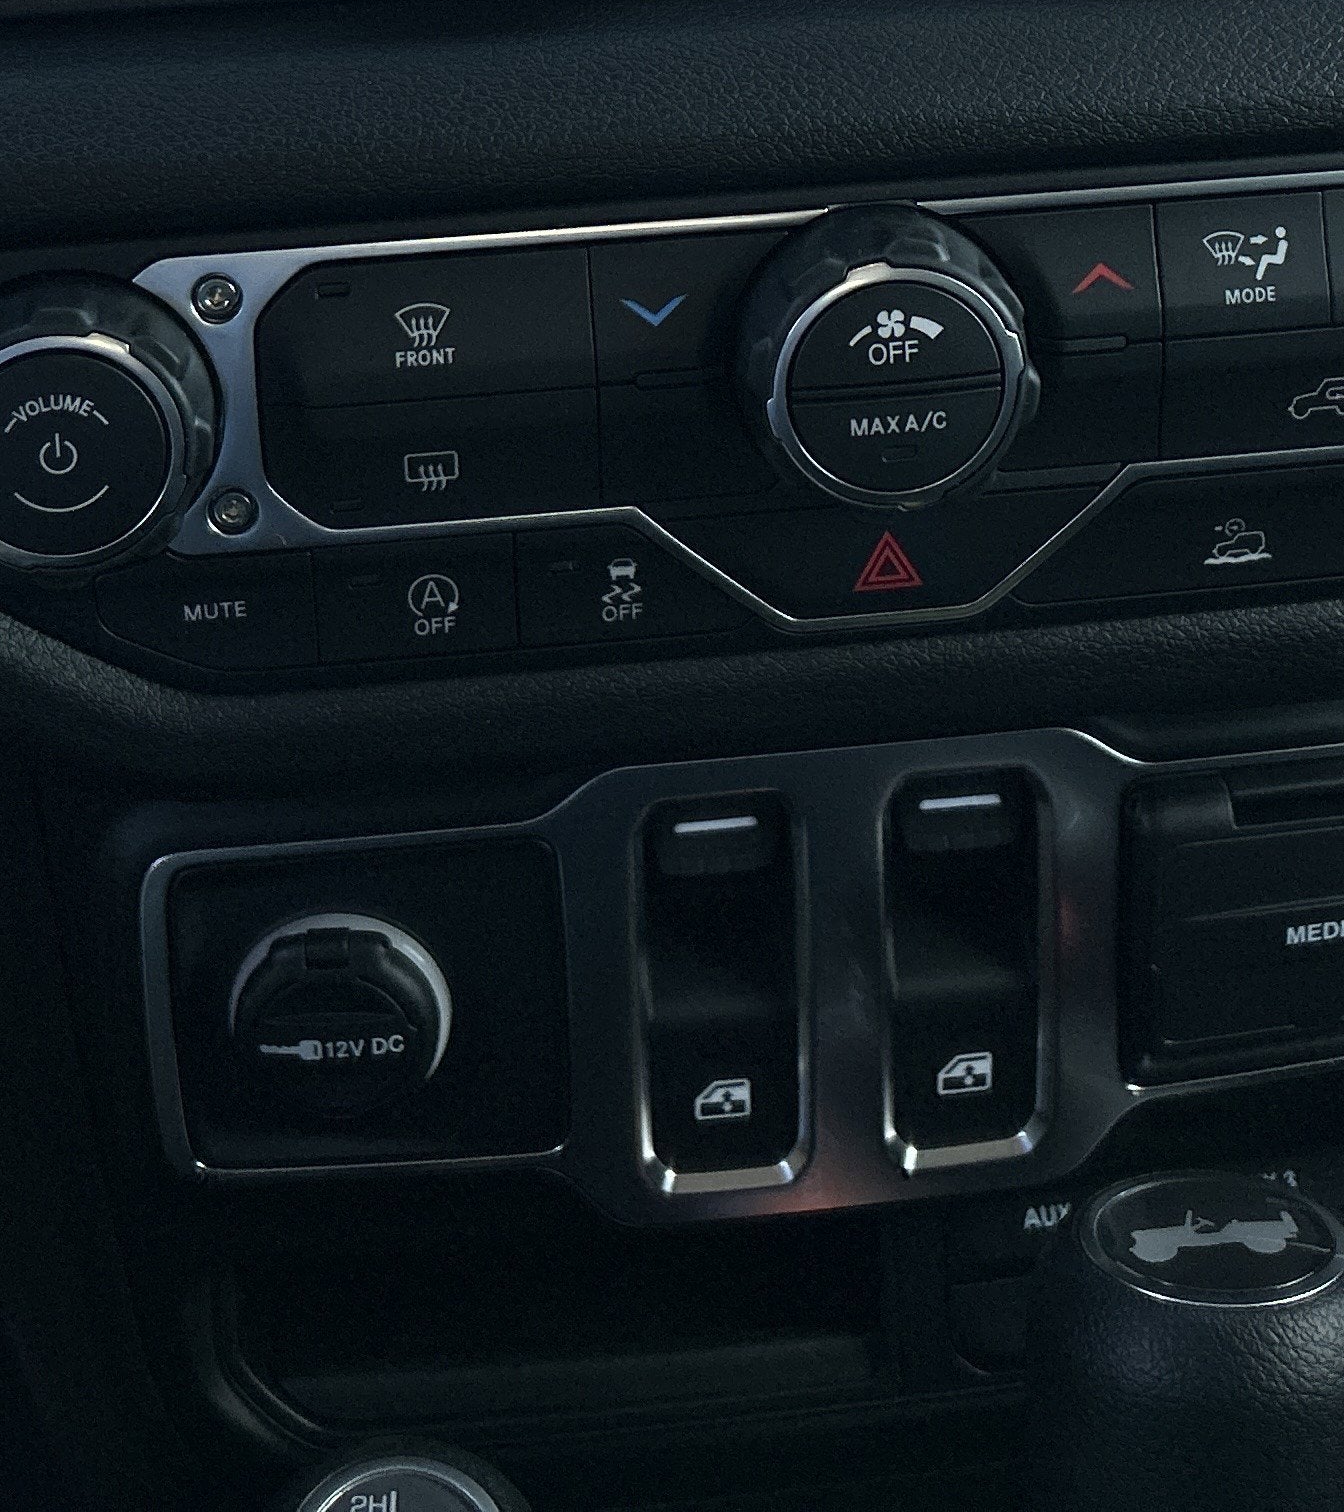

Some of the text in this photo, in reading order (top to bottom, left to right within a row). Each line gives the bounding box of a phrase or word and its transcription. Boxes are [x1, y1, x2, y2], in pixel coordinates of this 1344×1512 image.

[1224, 286, 1276, 306] MODE
[395, 347, 456, 366] FRONT
[868, 341, 919, 366] OFF
[14, 394, 94, 421] VOLUME
[850, 411, 948, 437] MAX A/C
[183, 601, 248, 622] MUTE
[602, 603, 643, 622] OFF
[414, 617, 456, 636] OFF
[326, 1034, 405, 1059] 12V DC
